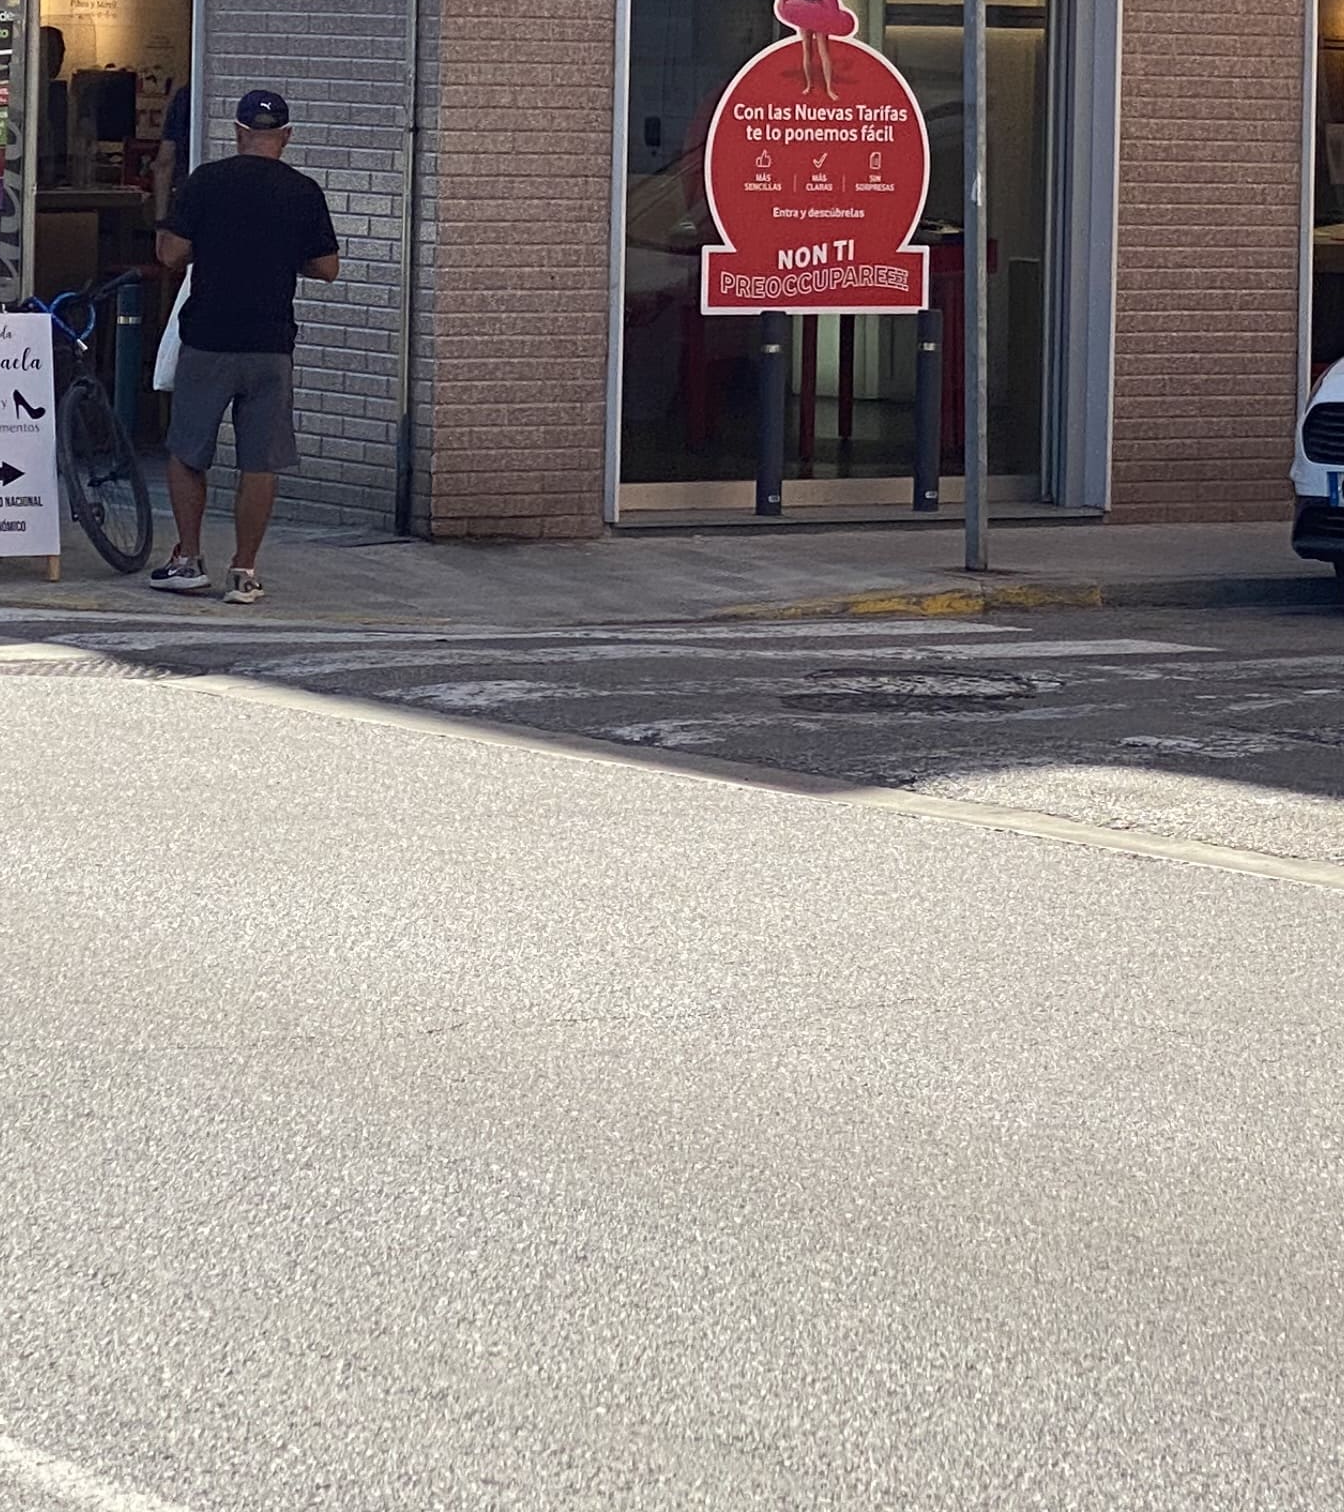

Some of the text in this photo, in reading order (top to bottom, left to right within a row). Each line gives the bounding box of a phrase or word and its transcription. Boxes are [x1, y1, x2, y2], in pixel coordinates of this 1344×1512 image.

[733, 103, 908, 122] Con las Nuevas Tarifas
[746, 124, 894, 145] te lo ponemos fácil
[869, 174, 882, 183] SIN
[744, 182, 895, 192] SENCILLAS CLARAS SORPRESAS
[772, 207, 865, 220] Entra y descúbrelas
[778, 239, 855, 270] NON TI
[0, 399, 8, 410] y
[4, 496, 44, 507] NACIONAL
